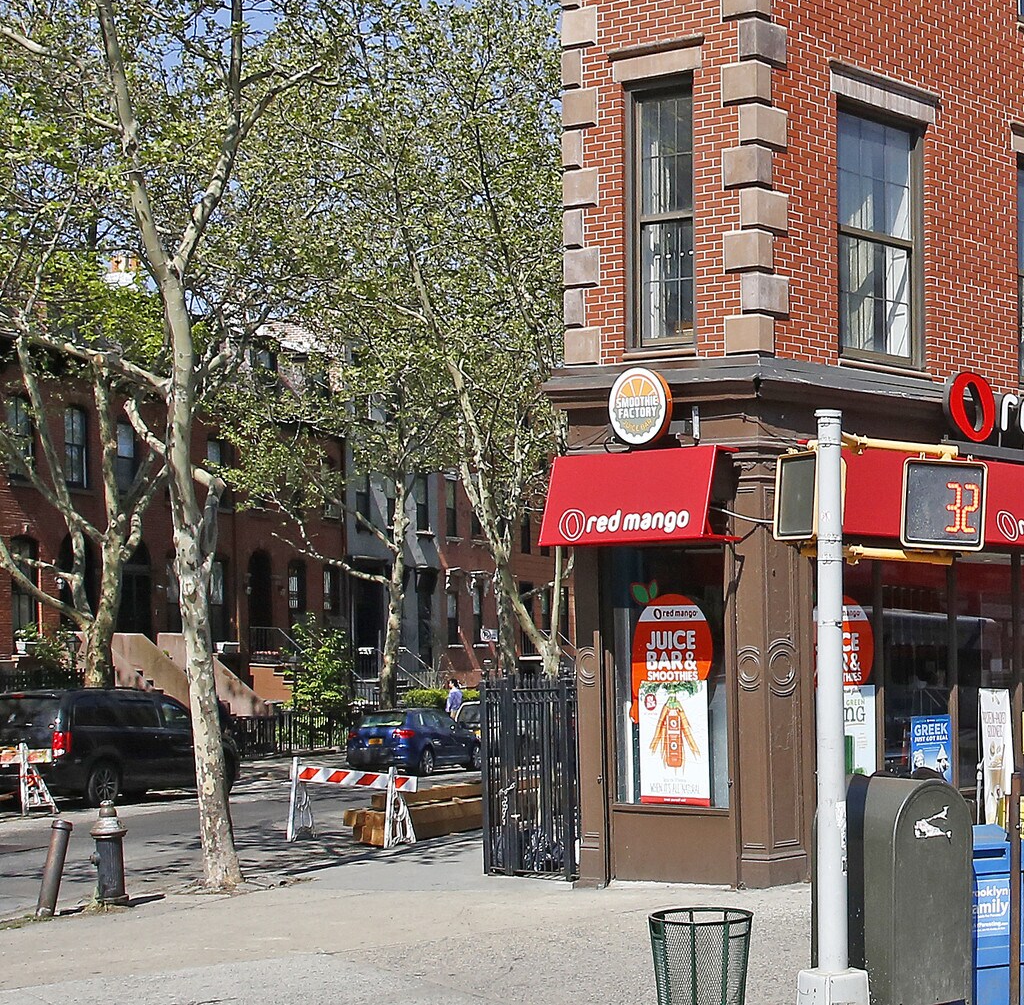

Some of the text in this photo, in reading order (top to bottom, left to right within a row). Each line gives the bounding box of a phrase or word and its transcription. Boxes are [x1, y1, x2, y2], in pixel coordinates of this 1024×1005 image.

[616, 395, 659, 408] SMOOTHIE
[618, 406, 658, 419] FACTORY
[945, 481, 981, 534] 32
[586, 508, 690, 534] red mango
[663, 609, 697, 618] red mango
[646, 630, 696, 650] JUICE
[646, 651, 697, 670] BAR &
[647, 670, 698, 681] SMOOTHIES
[914, 723, 948, 736] GREEK
[914, 735, 925, 743] JUST
[936, 734, 948, 742] REAL
[972, 885, 1009, 900] rooklyn
[972, 899, 1009, 916] amily
